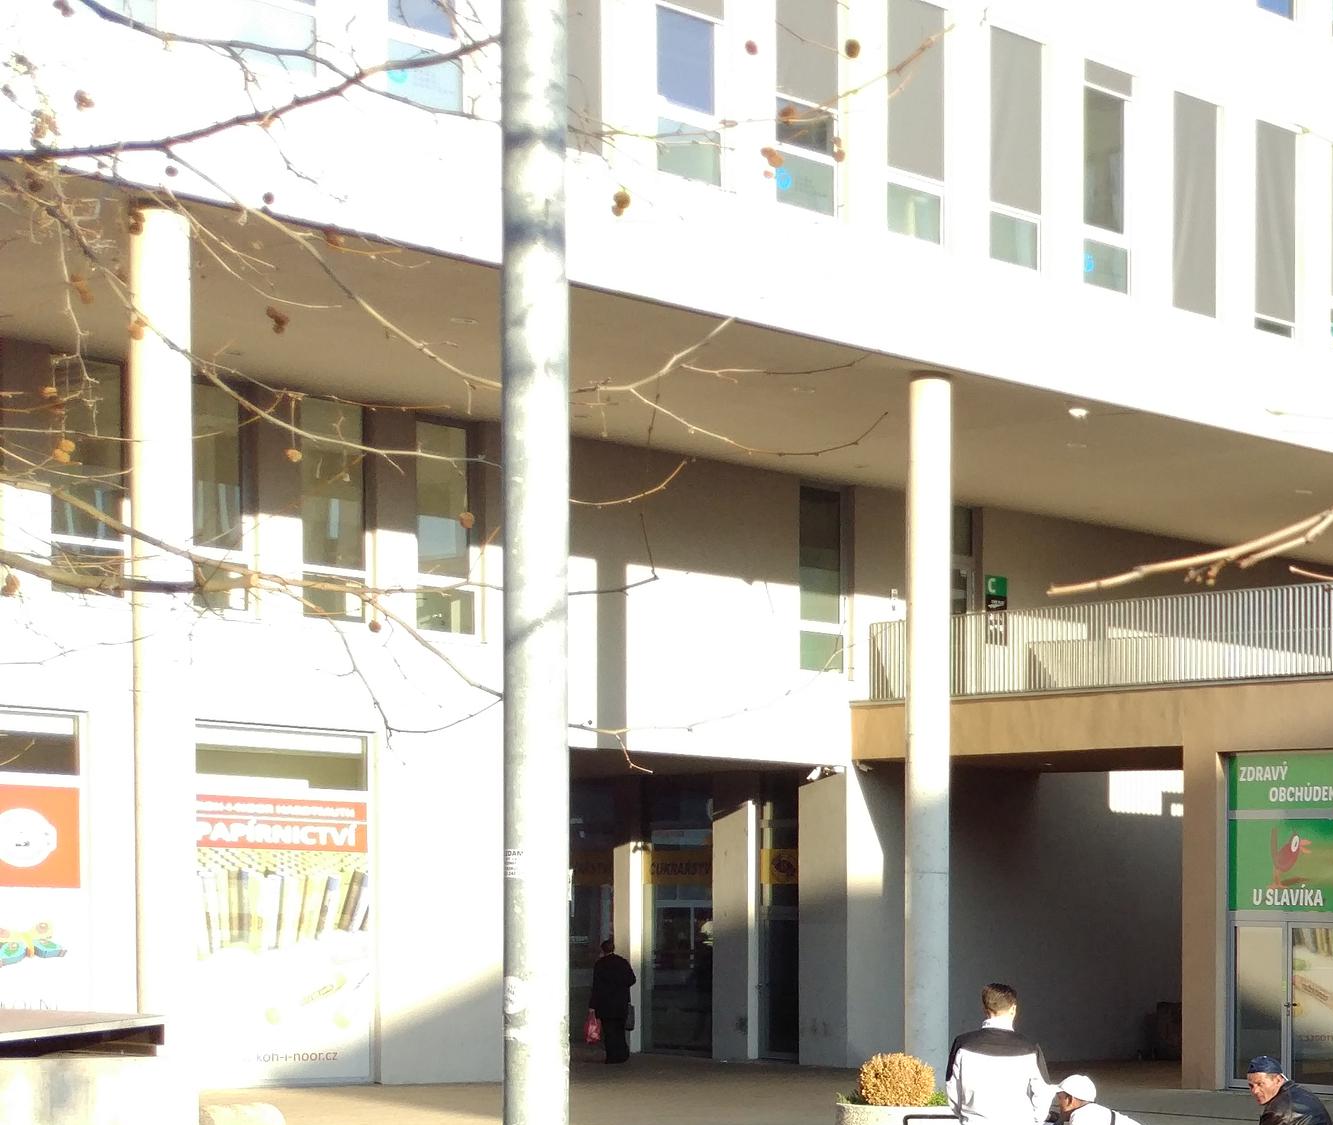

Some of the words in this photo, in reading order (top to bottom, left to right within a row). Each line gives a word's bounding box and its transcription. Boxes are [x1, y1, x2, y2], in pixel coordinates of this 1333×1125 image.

[987, 577, 997, 594] C
[1239, 761, 1289, 782] ZDRAVÝ
[1252, 888, 1263, 906] U
[1266, 884, 1324, 906] SLAVÍKA
